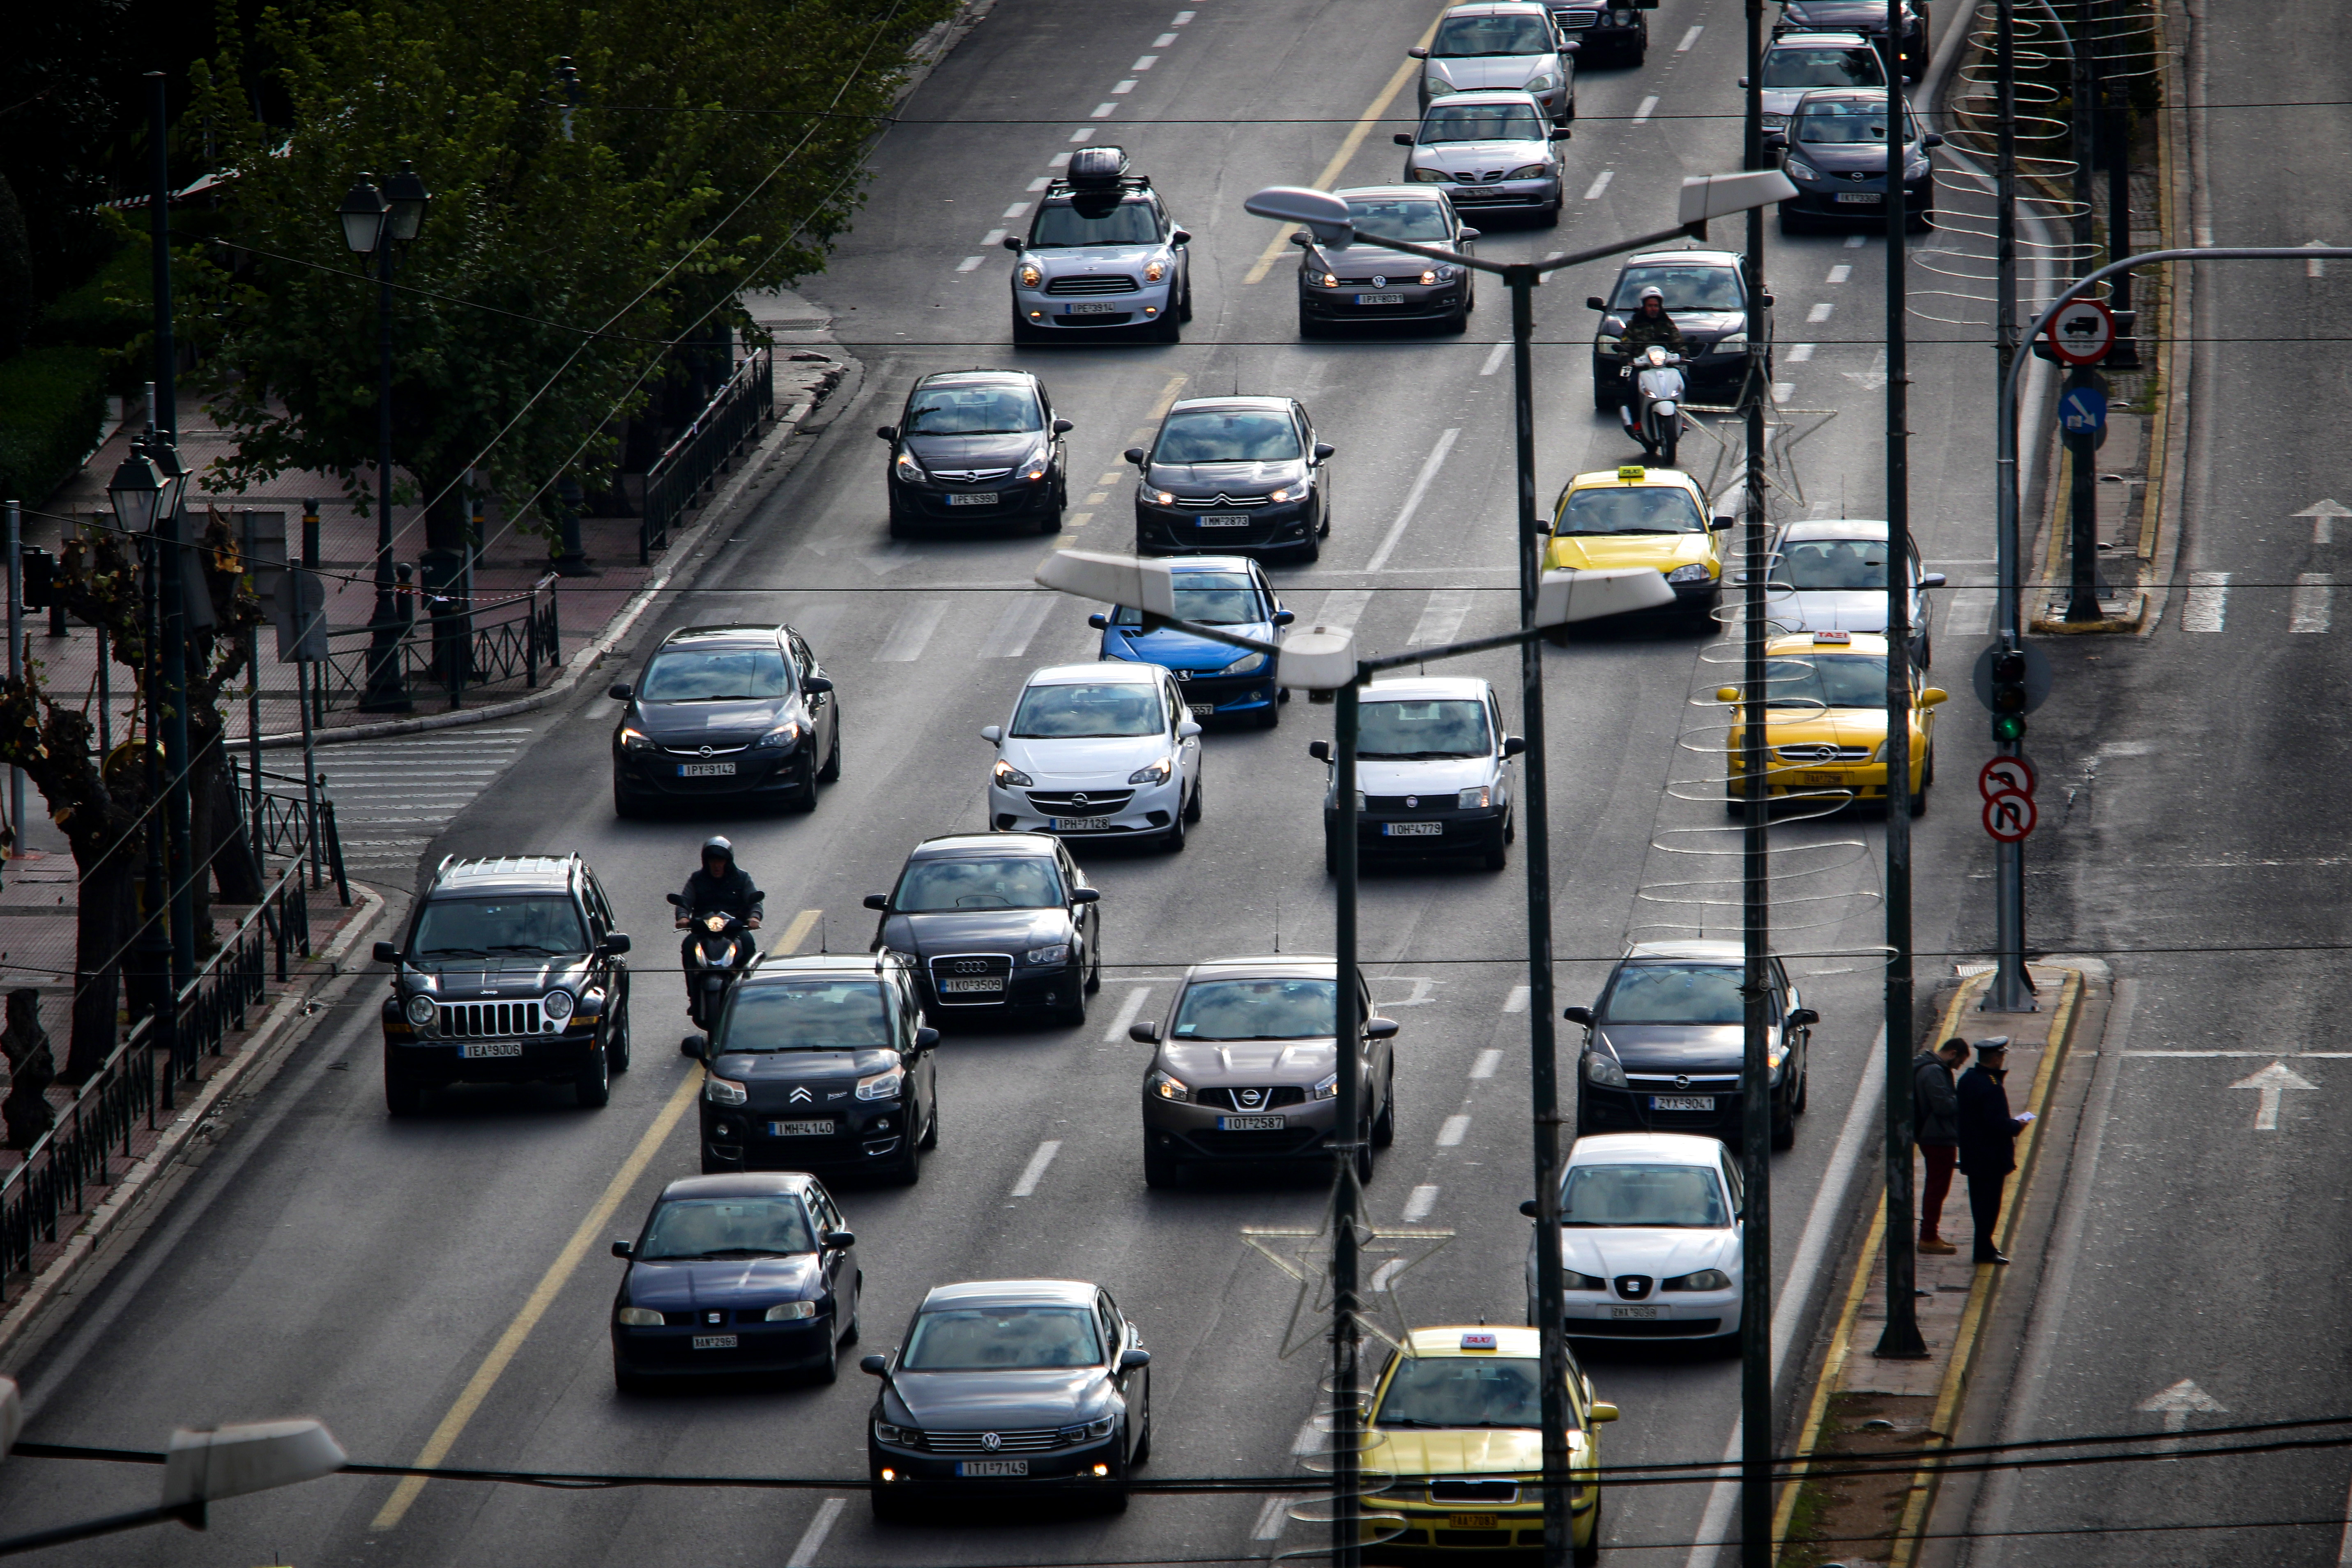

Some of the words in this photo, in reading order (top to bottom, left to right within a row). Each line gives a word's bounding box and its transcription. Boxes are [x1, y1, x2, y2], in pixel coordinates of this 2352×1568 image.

[1073, 303, 1114, 313] IPE-3914
[687, 764, 734, 776] IPY-9142
[1059, 818, 1108, 829] IPH-7128
[1392, 823, 1441, 835] IOH-4779
[779, 1122, 833, 1135] IMH-4140
[1229, 1117, 1282, 1129] IOT-2587
[968, 1462, 1026, 1474] ITI-7149
